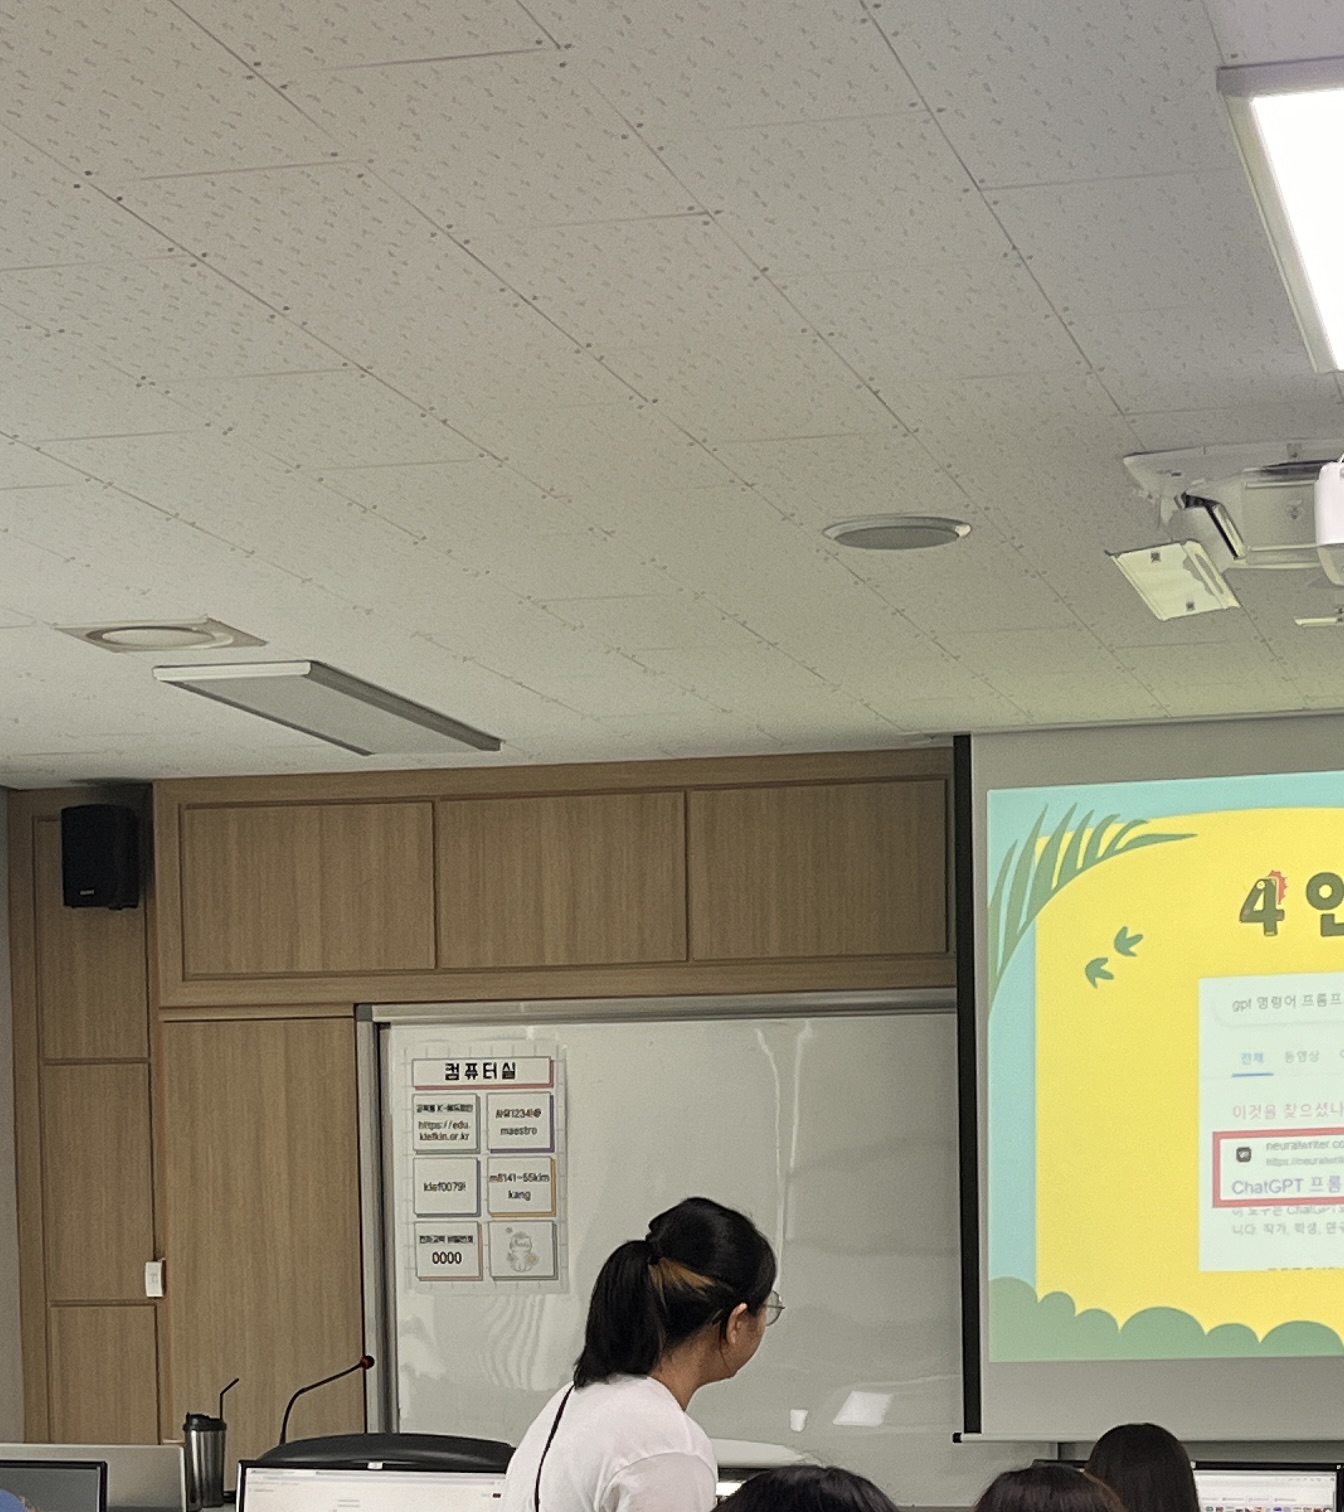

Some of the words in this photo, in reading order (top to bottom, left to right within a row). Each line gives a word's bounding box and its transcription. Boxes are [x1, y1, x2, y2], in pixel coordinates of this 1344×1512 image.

[1239, 877, 1285, 936] 4
[1232, 998, 1251, 1012] gpt
[1257, 995, 1296, 1010] 명령어
[1241, 1052, 1264, 1065] 전체
[1284, 1050, 1319, 1063] 동영상
[445, 1062, 516, 1081] 컴퓨터실
[1232, 1104, 1277, 1120] 이것을
[1231, 1177, 1304, 1195] ChatGPT
